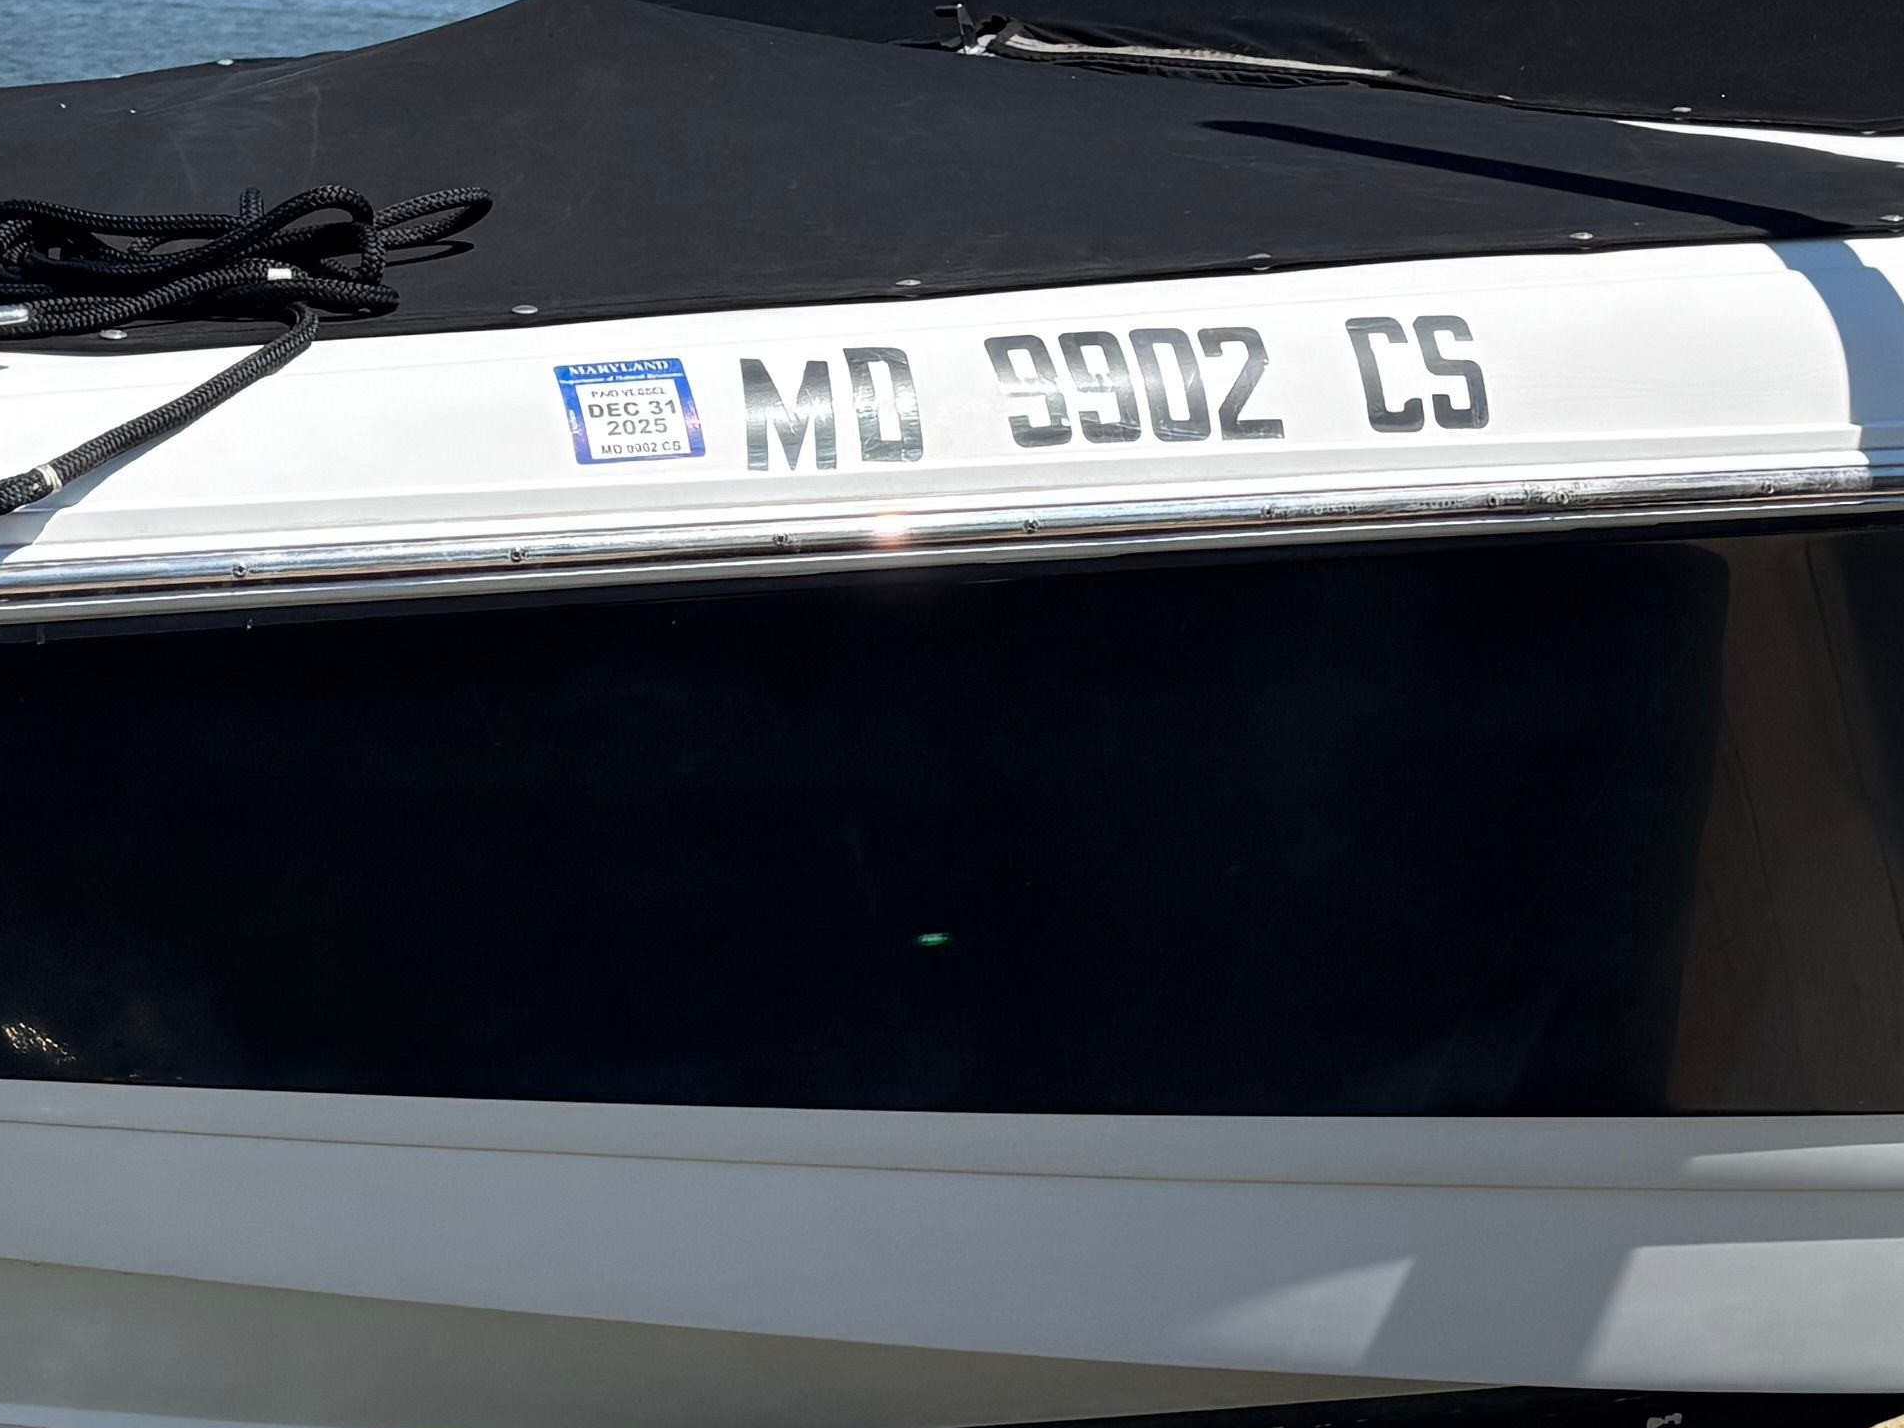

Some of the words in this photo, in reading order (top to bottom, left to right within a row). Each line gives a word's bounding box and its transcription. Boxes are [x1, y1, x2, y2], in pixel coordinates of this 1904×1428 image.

[568, 360, 669, 375] MARYLAND
[740, 347, 924, 471] MD
[984, 327, 1285, 448] 9902
[1345, 315, 1489, 433] CS
[588, 401, 641, 418] DEC
[648, 399, 676, 414] 31
[606, 418, 668, 436] 2025
